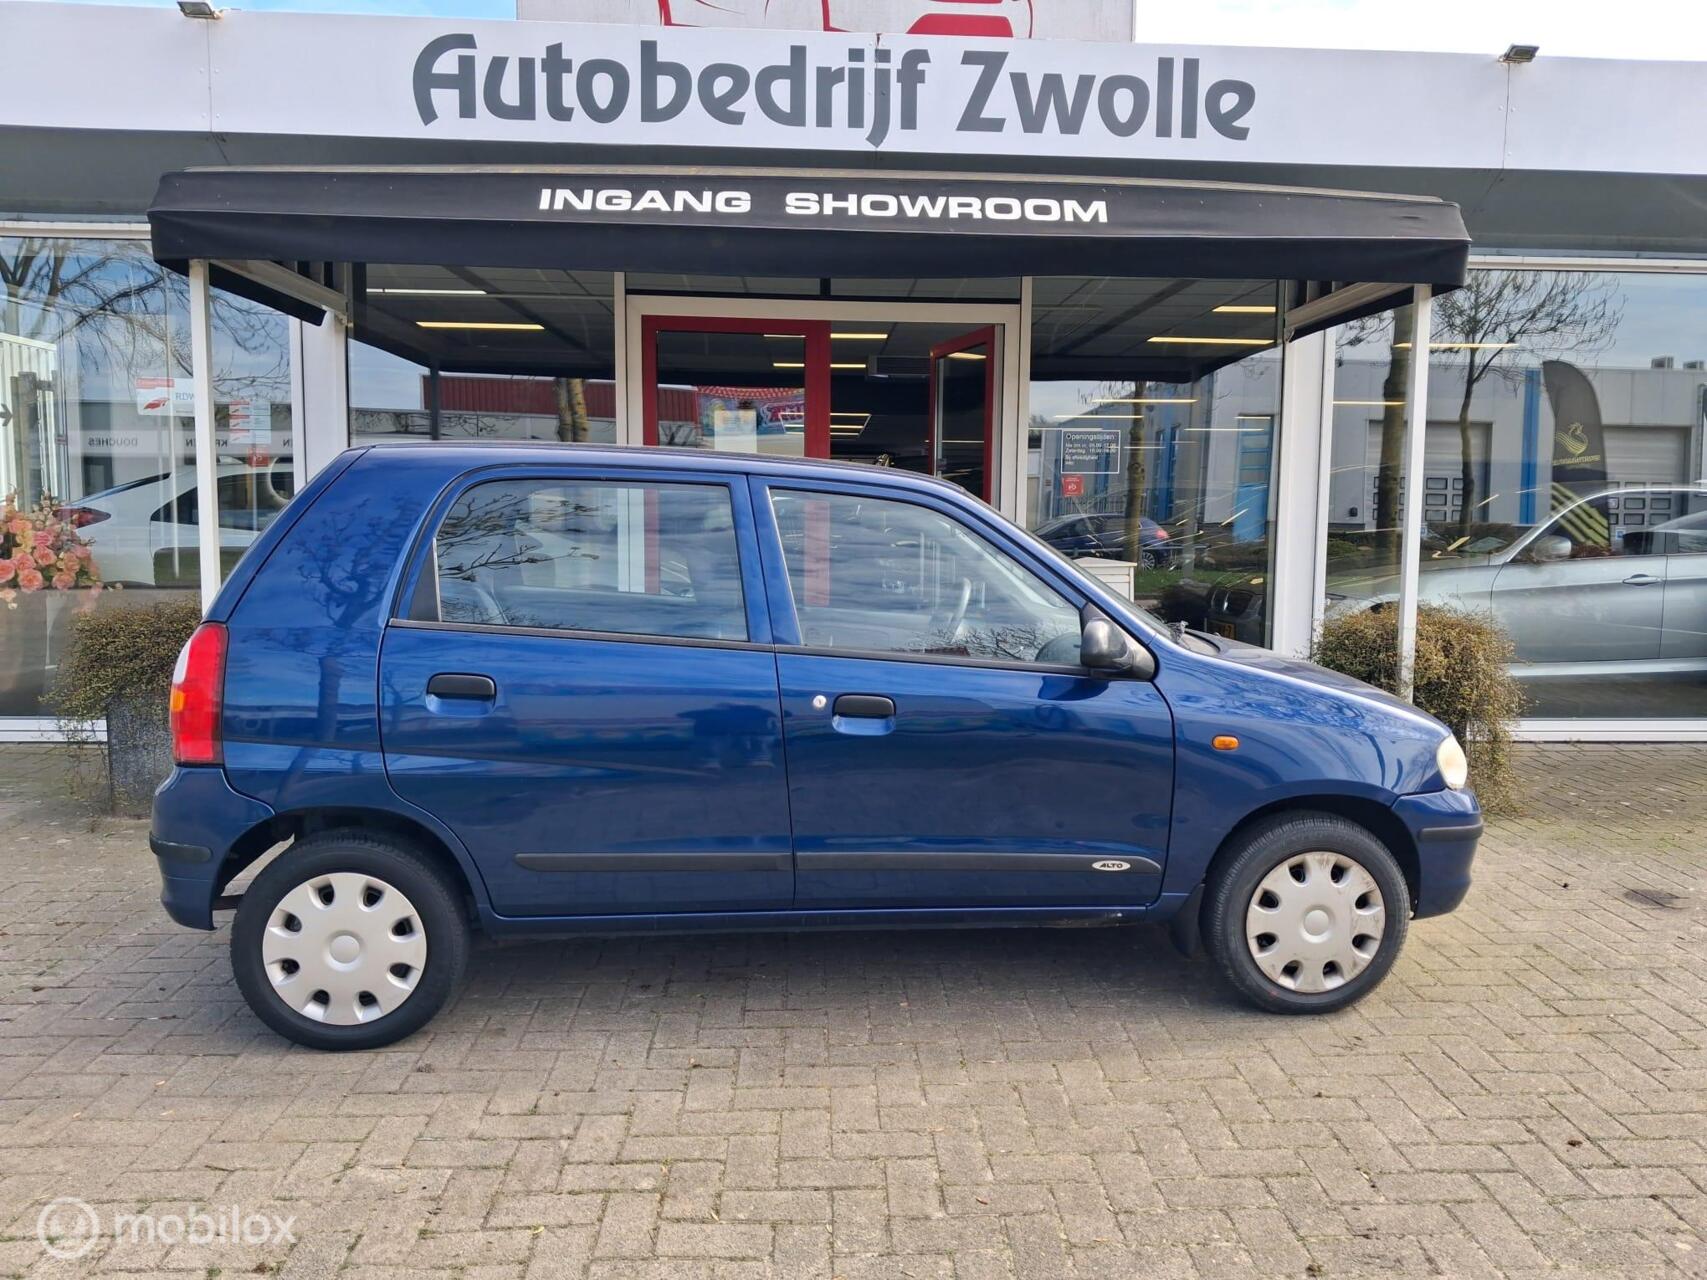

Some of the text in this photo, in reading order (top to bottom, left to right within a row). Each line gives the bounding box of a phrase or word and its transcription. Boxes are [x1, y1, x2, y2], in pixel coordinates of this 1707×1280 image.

[413, 33, 1256, 148] Autobedrijf Zwolle
[538, 188, 1108, 223] INGANG SHOWROOM
